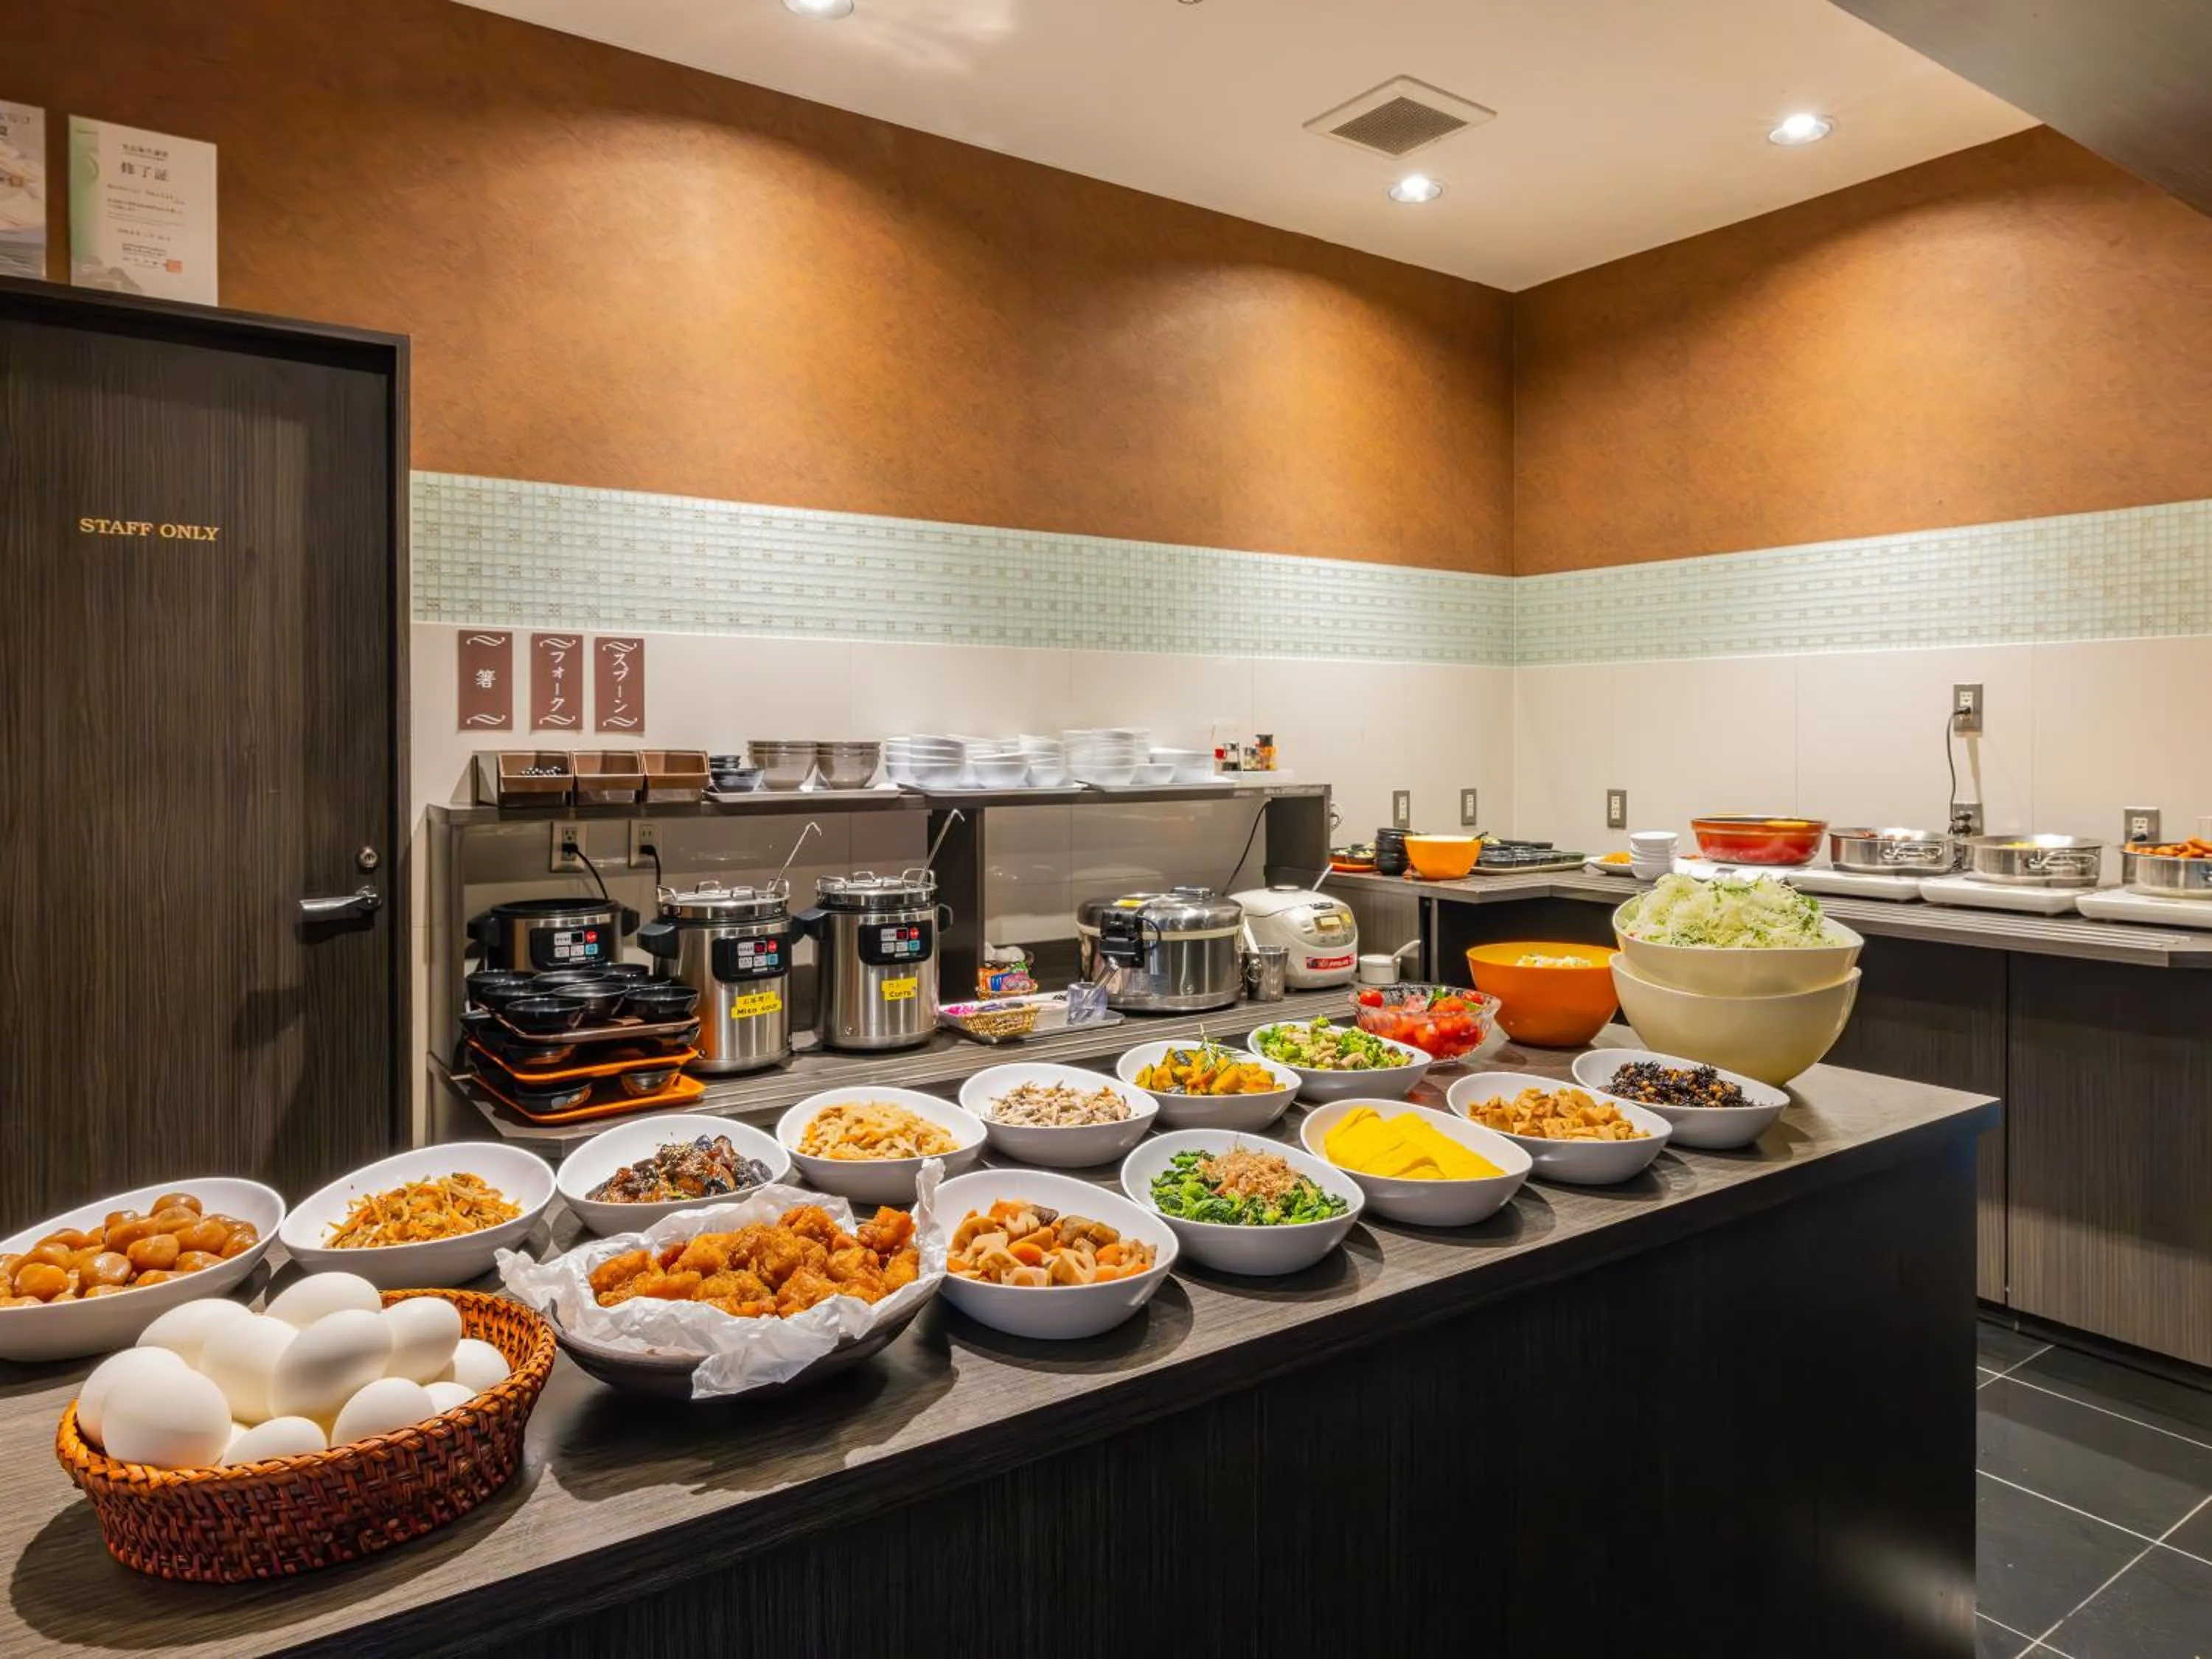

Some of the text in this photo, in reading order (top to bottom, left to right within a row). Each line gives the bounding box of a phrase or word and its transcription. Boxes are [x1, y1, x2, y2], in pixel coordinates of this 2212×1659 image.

[79, 518, 220, 541] STAFF ONLY
[476, 669, 495, 689] 箸
[550, 651, 566, 712] フォーク
[613, 653, 629, 713] スプーン
